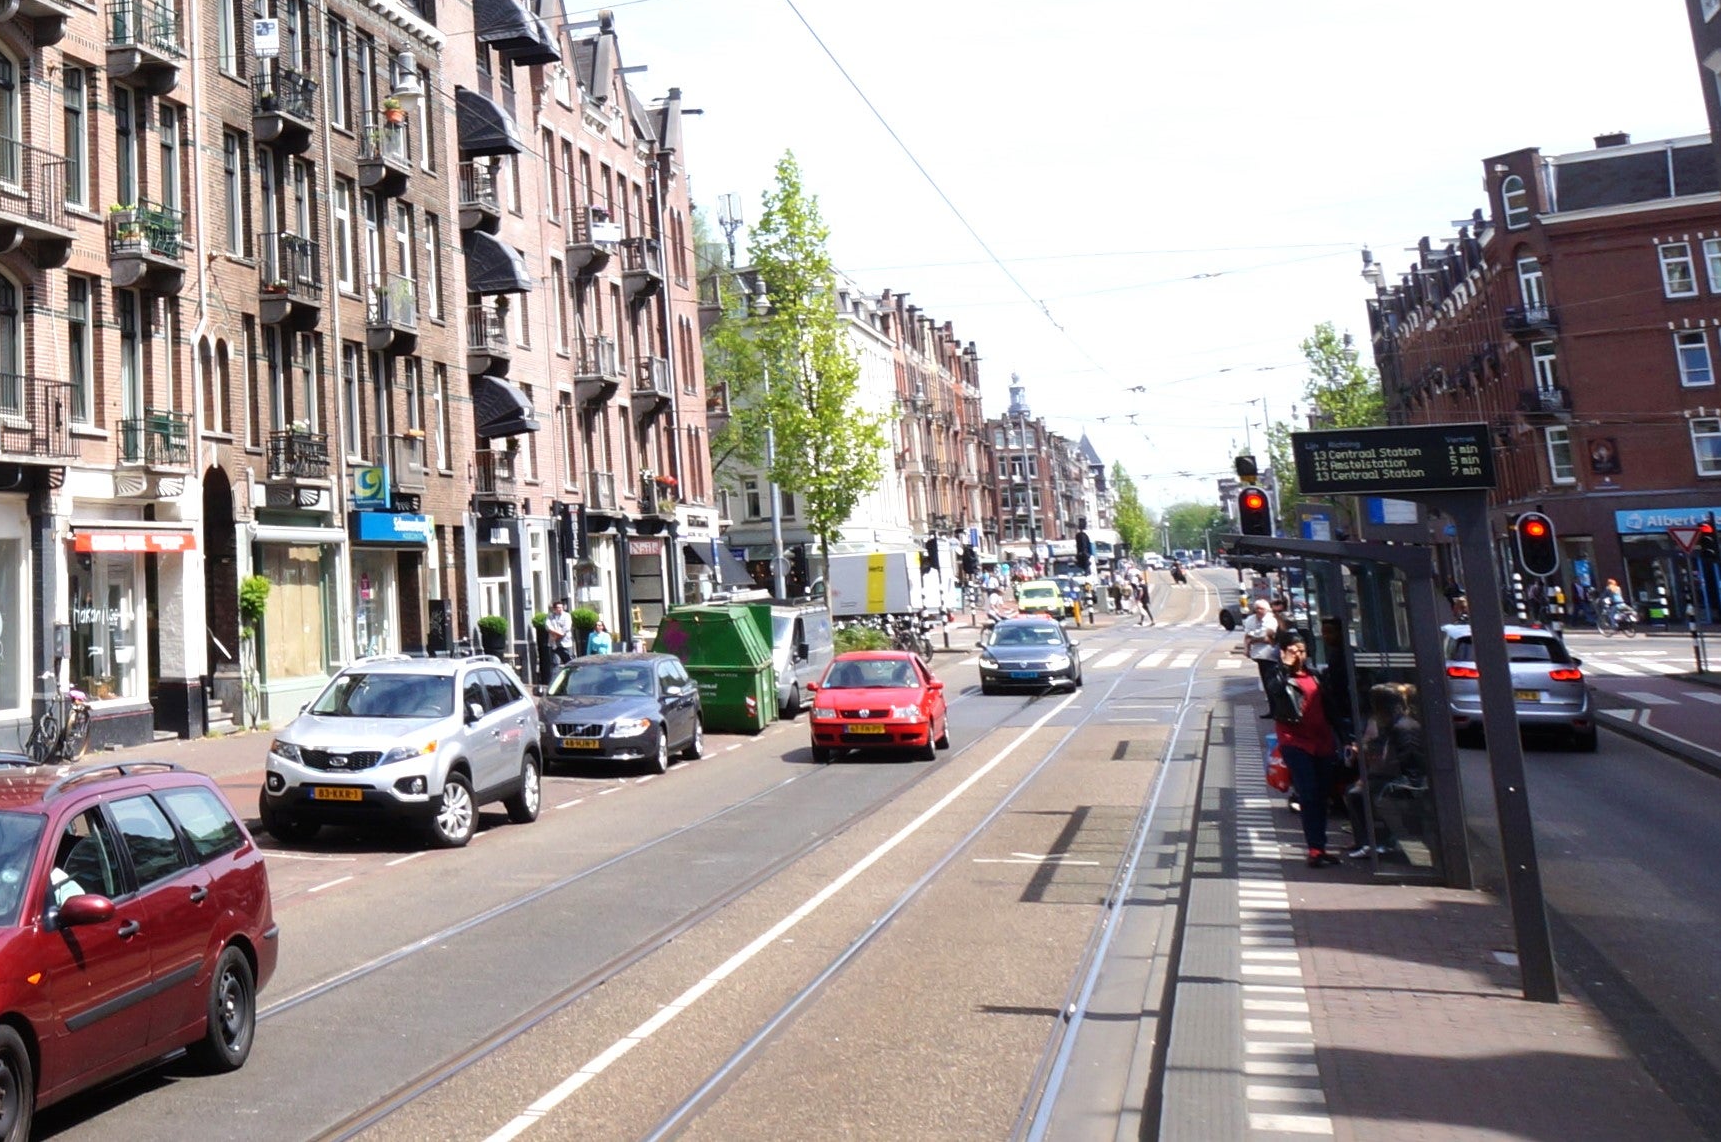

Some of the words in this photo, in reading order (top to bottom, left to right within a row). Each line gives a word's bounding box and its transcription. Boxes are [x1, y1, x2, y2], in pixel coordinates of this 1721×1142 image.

[1313, 450, 1327, 460] 13
[1328, 448, 1376, 460] Centraal
[1380, 447, 1422, 457] Station
[1448, 445, 1454, 454] 1
[1458, 445, 1478, 454] min
[1315, 461, 1328, 471] 12
[1330, 459, 1407, 470] Amstelstation
[1450, 456, 1457, 465] 5
[1461, 456, 1480, 465] min
[1316, 472, 1329, 482] 13
[1331, 470, 1379, 481] Centraal
[1383, 468, 1425, 479] Station
[1462, 466, 1482, 475] min
[1647, 515, 1696, 527] Albert
[318, 788, 359, 799] 83-KKR-1
